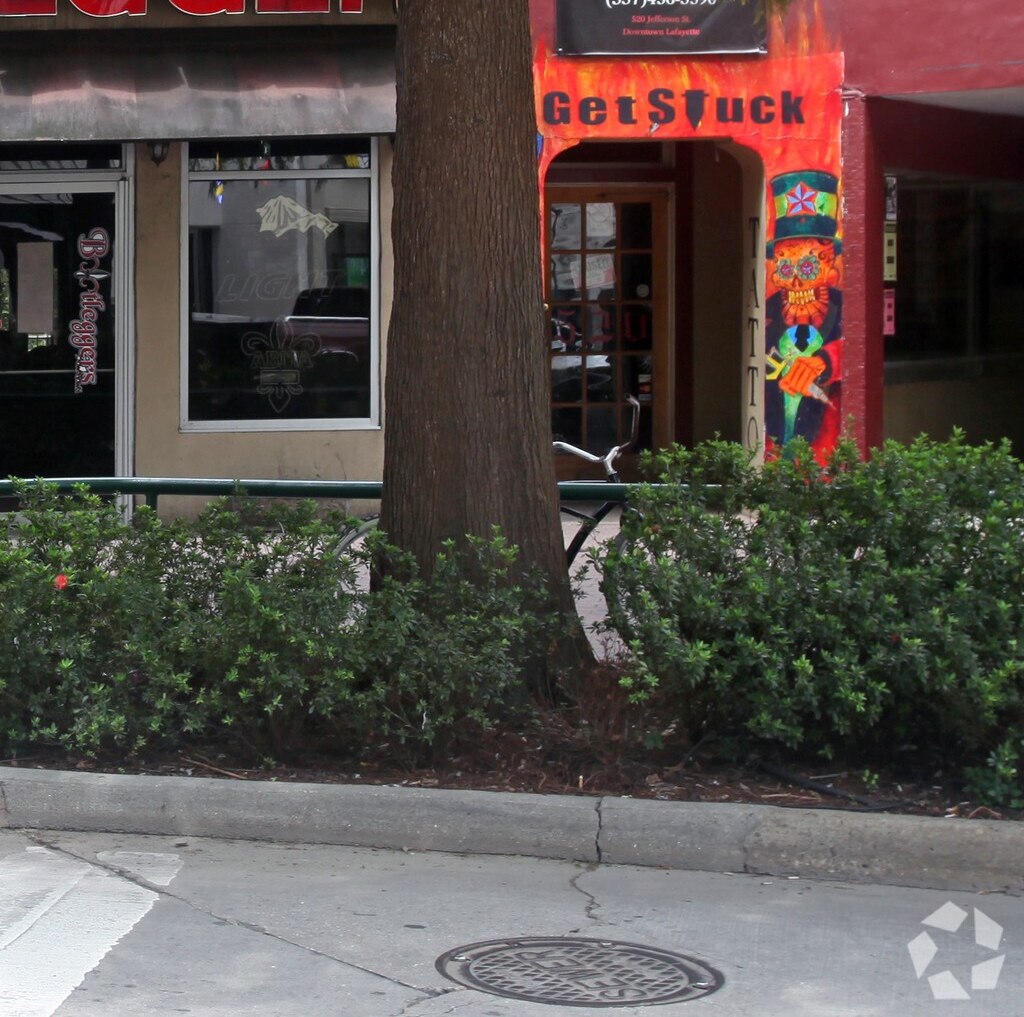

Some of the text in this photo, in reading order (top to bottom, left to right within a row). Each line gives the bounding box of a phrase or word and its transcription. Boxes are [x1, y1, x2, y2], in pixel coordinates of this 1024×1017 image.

[631, 15, 646, 23] 520
[647, 14, 680, 24] Jefferson
[623, 27, 701, 37] Downtown Lafayette
[513, 950, 648, 1001] SEWER
